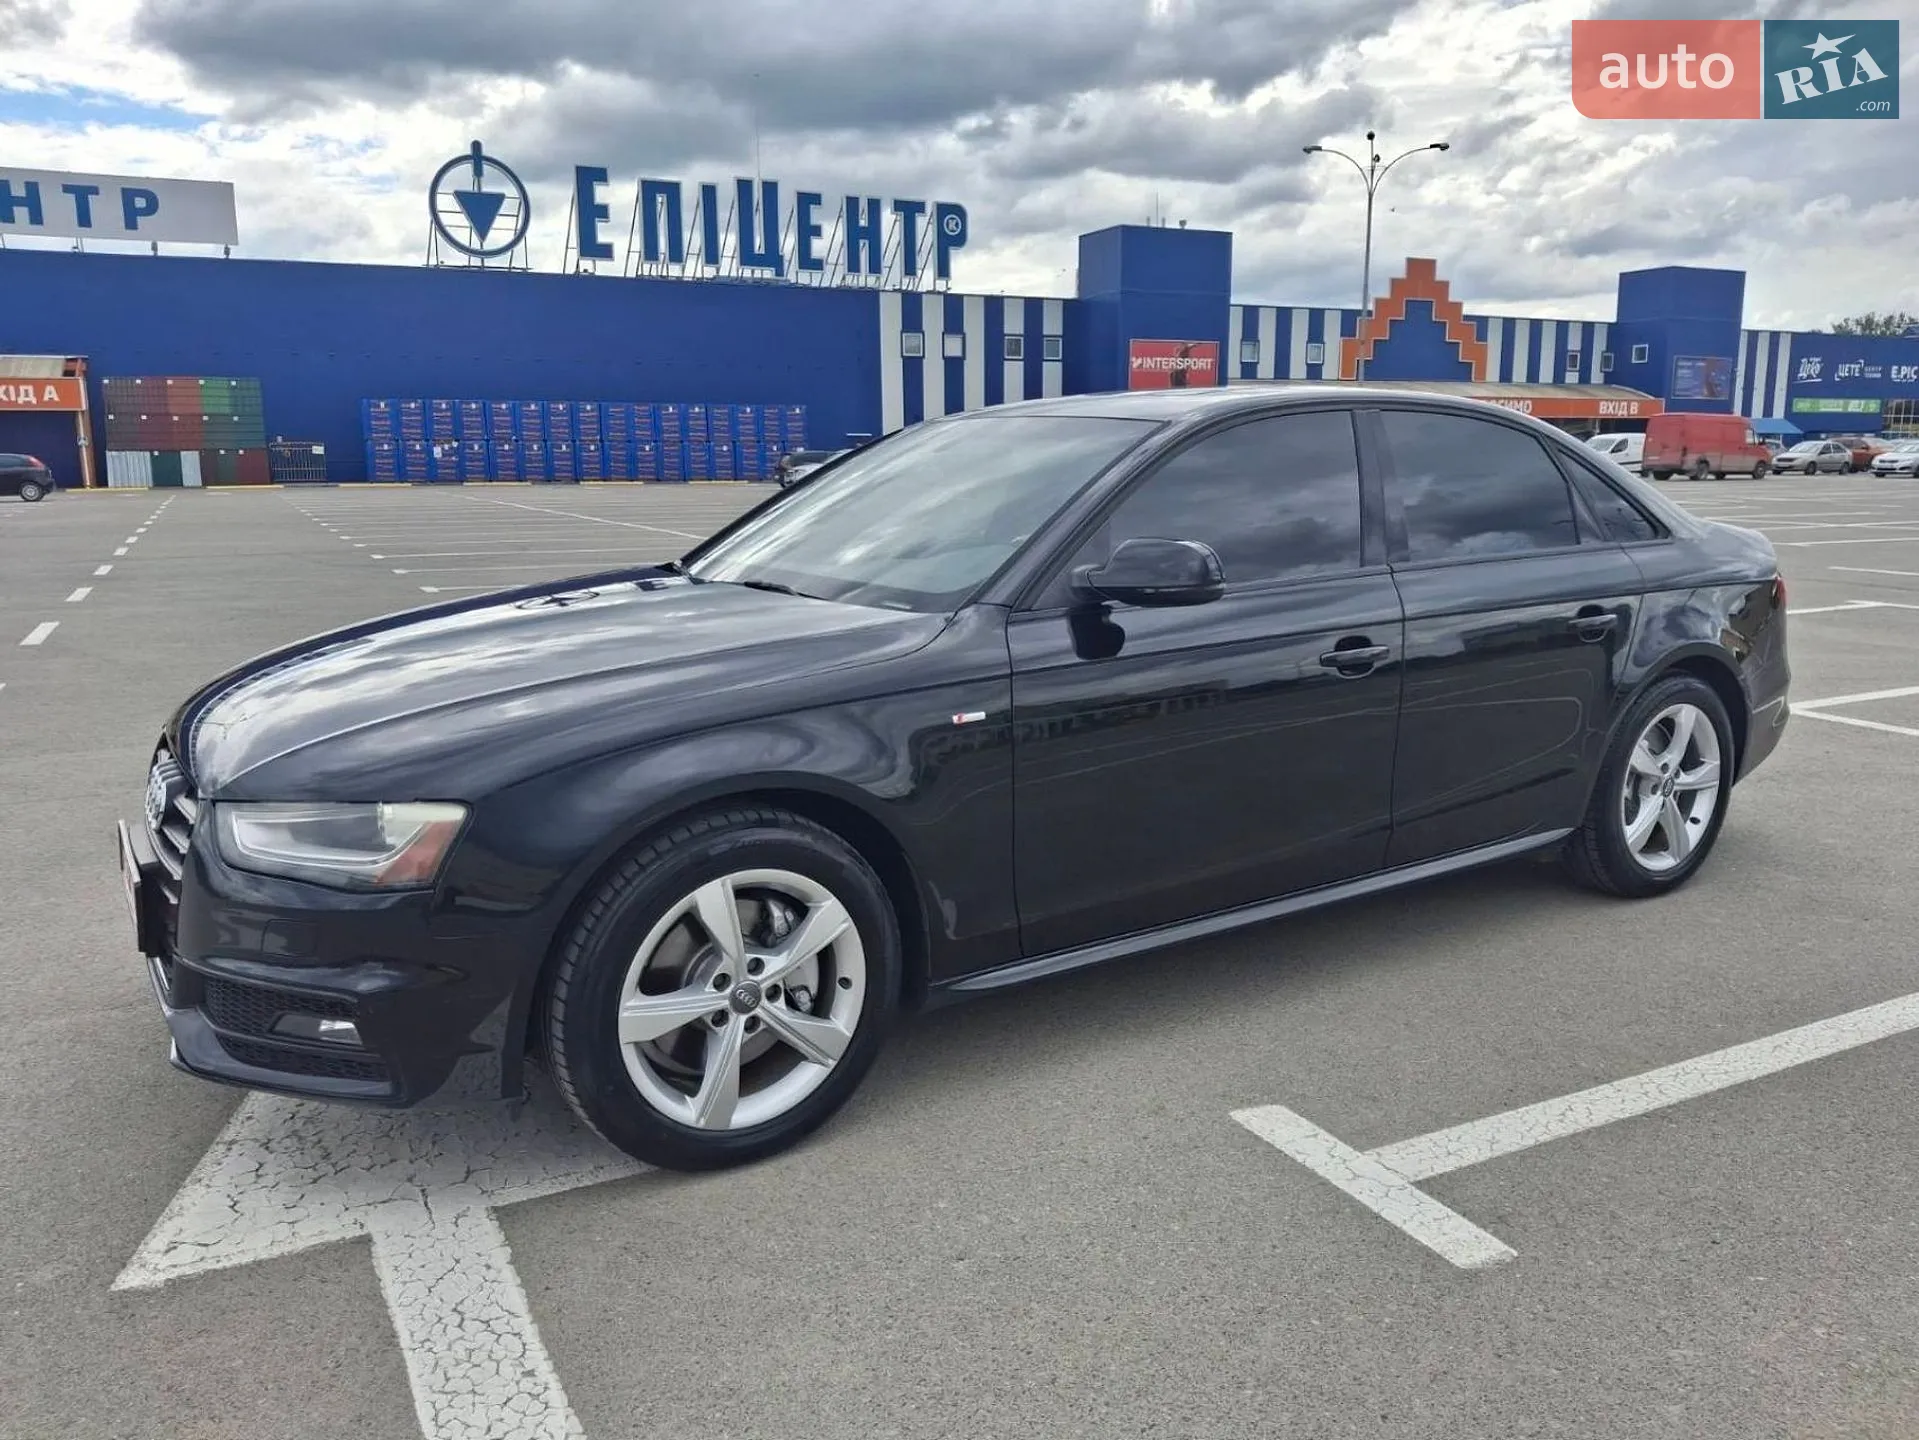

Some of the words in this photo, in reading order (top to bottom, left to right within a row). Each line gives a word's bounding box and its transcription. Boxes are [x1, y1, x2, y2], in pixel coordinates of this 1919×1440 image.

[0, 178, 159, 231] НТР
[575, 165, 969, 279] ЕПІЦЕНТР
[1142, 357, 1213, 369] INTERSPORT
[43, 385, 61, 404] А
[1599, 400, 1628, 416] ВХІД
[1629, 401, 1638, 414] В
